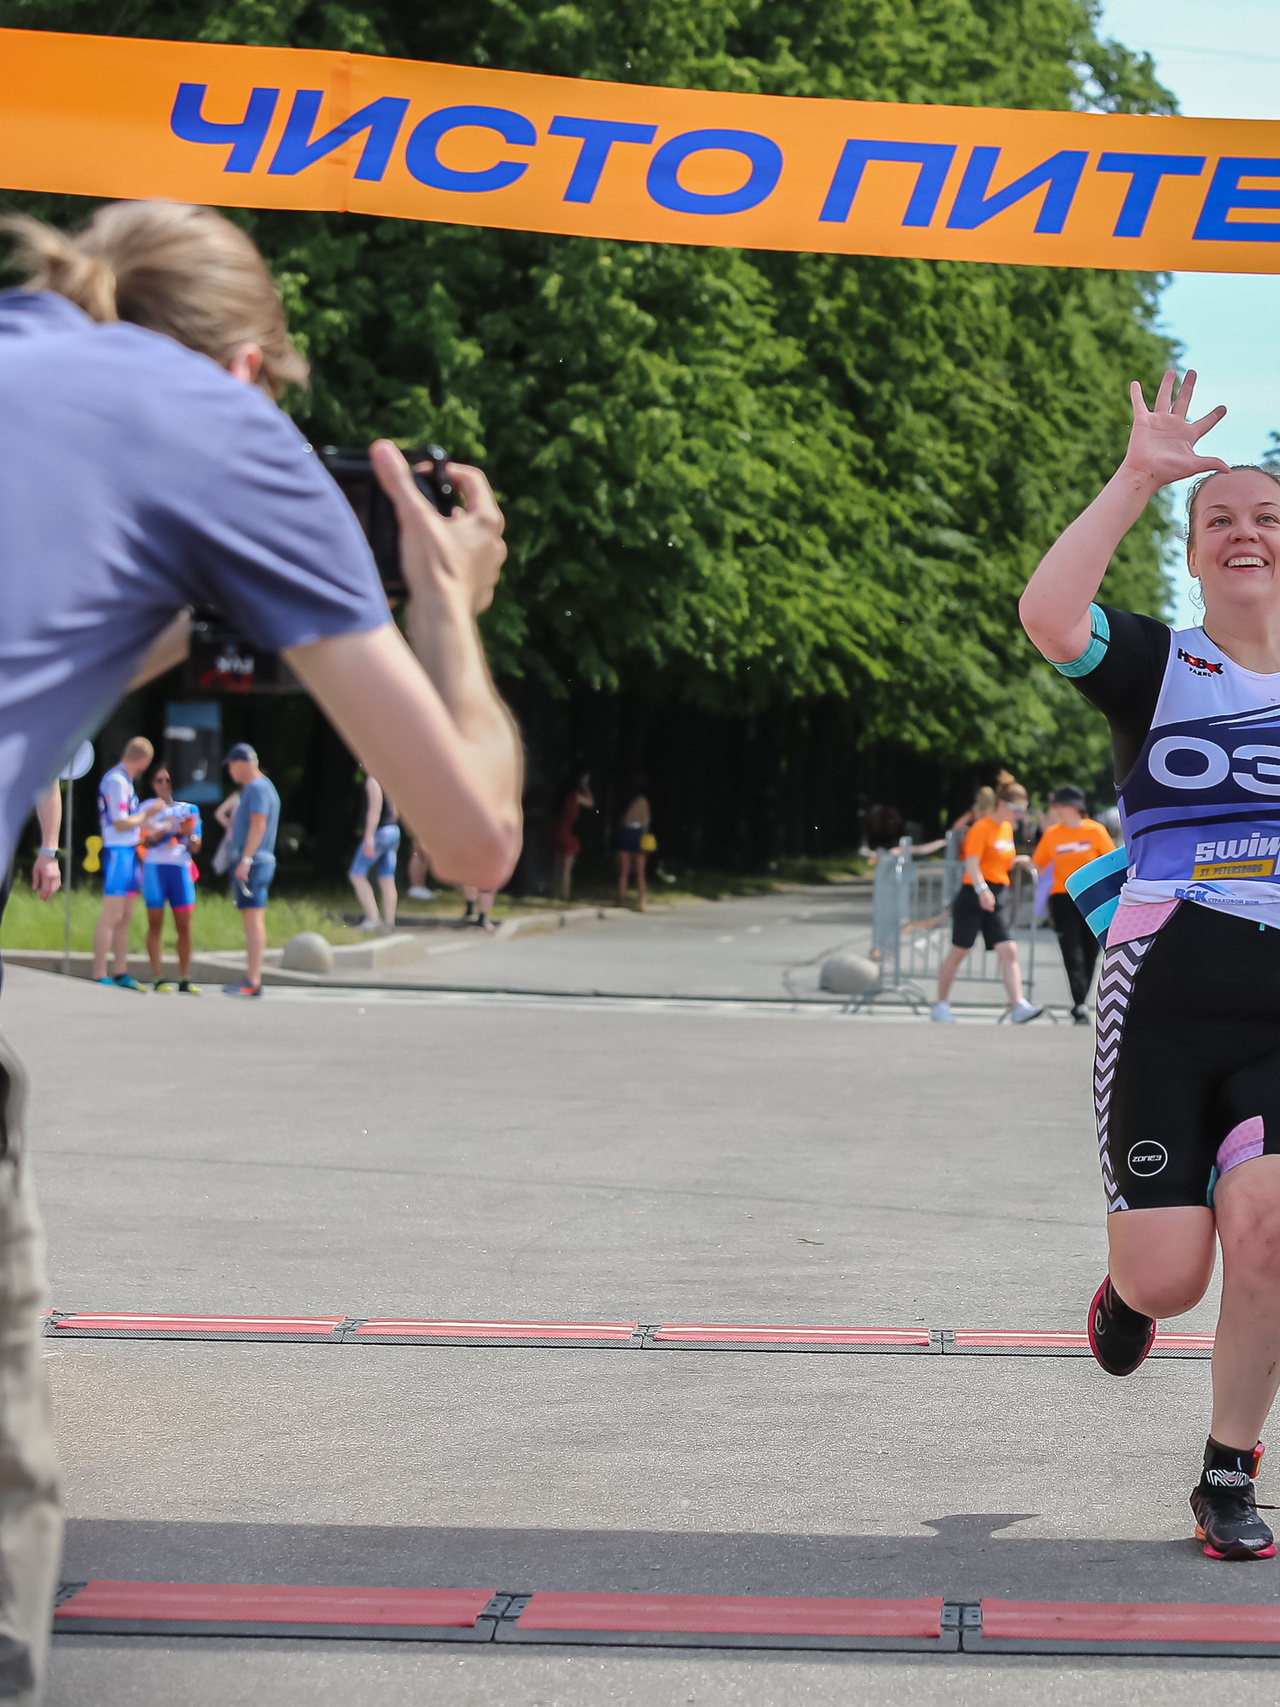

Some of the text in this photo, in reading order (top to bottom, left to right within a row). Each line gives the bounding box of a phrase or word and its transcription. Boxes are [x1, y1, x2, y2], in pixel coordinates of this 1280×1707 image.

[170, 82, 784, 216] ЧИСТО
[1213, 863, 1264, 876] PETERSBURG
[1174, 887, 1208, 902] ВСК
